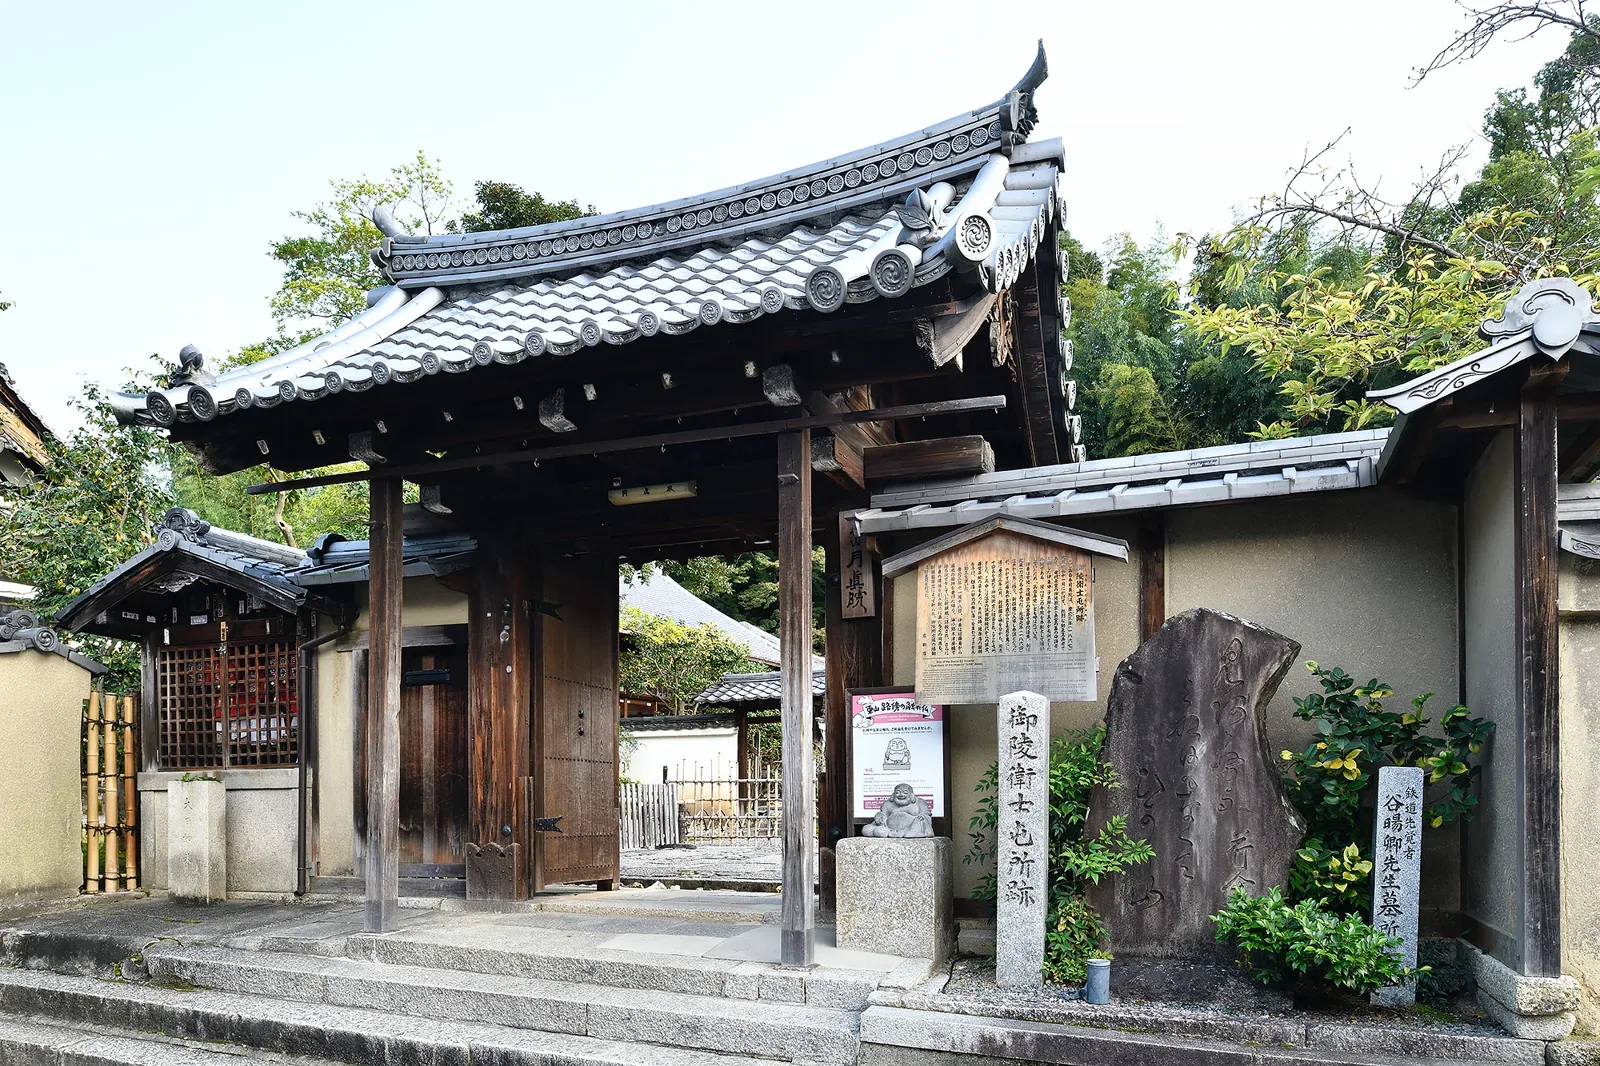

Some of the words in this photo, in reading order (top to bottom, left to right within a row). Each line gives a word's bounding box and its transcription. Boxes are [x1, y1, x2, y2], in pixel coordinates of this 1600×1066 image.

[1006, 705, 1039, 907] 御陵衛士屯所跡
[1403, 786, 1419, 860] 鉄道先覚者
